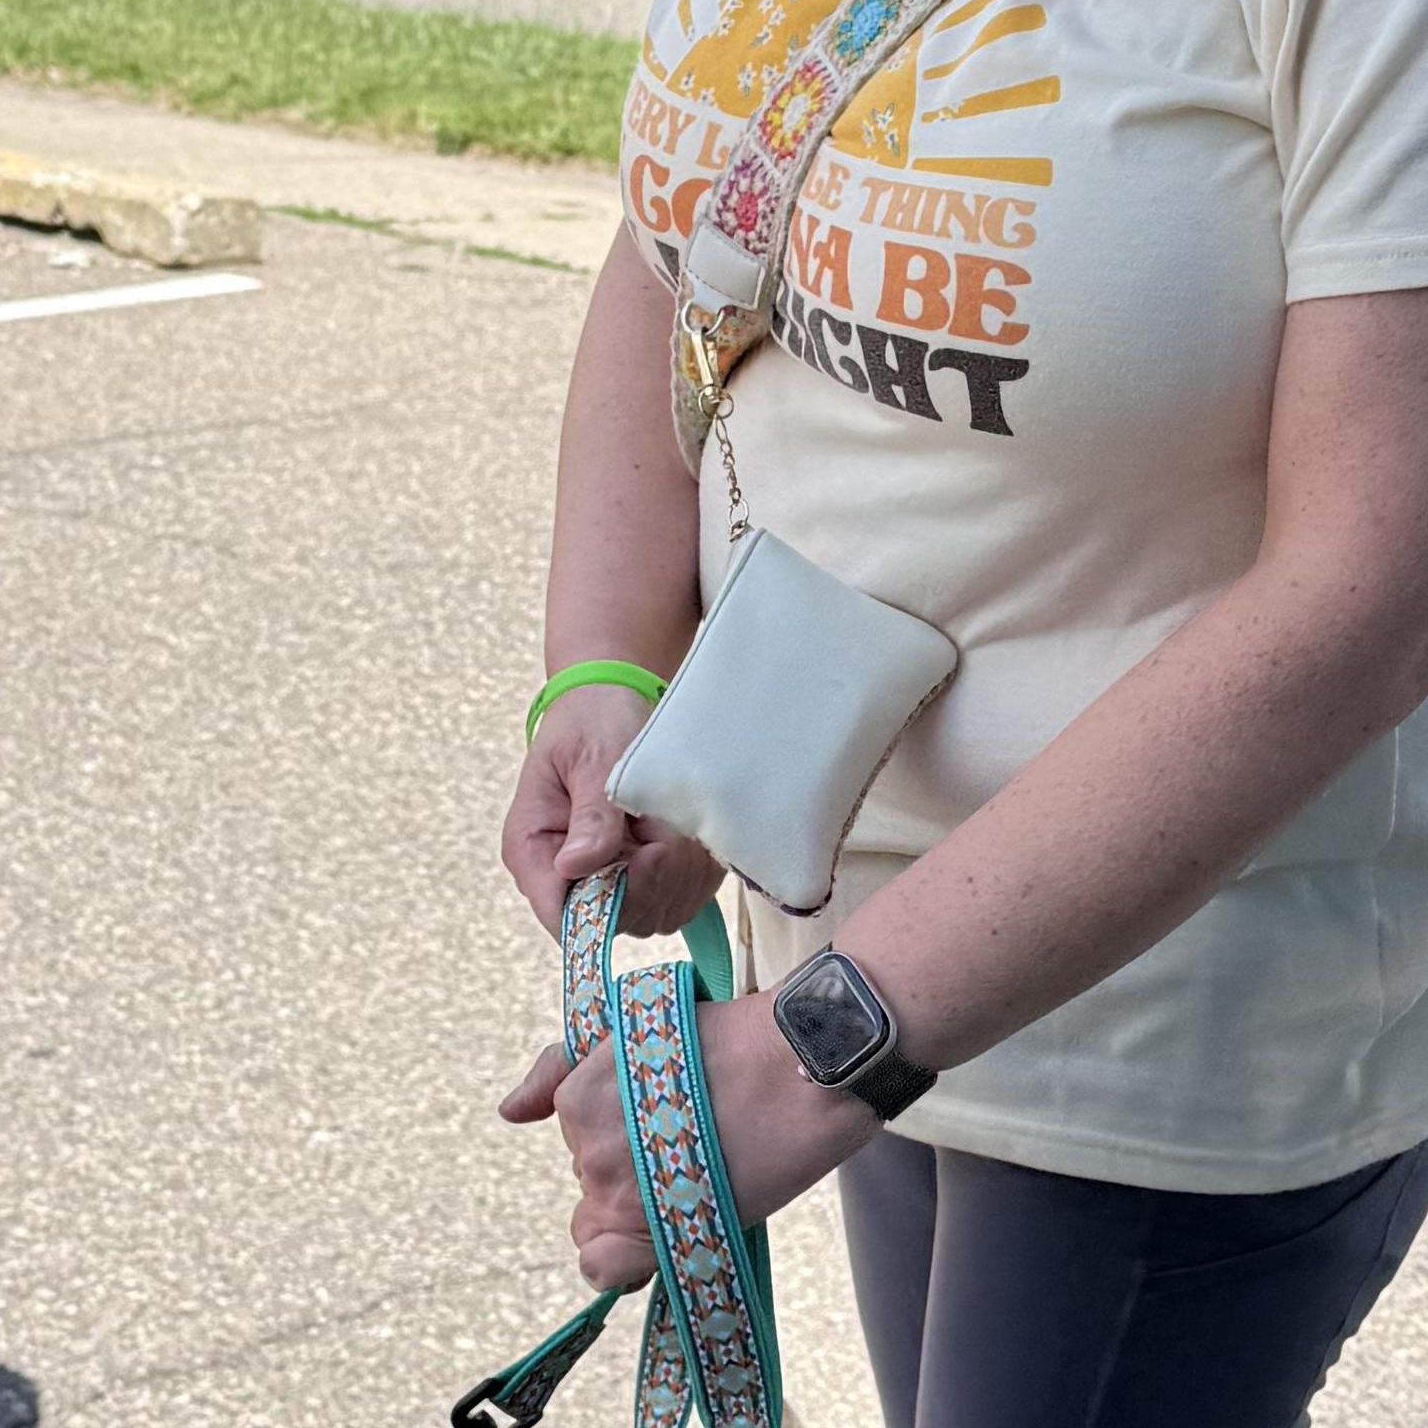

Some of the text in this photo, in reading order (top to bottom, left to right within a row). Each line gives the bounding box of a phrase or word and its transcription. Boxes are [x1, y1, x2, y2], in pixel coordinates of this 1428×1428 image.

[628, 79, 696, 156] ERY
[859, 176, 1037, 250] THING
[876, 240, 1032, 347] BE
